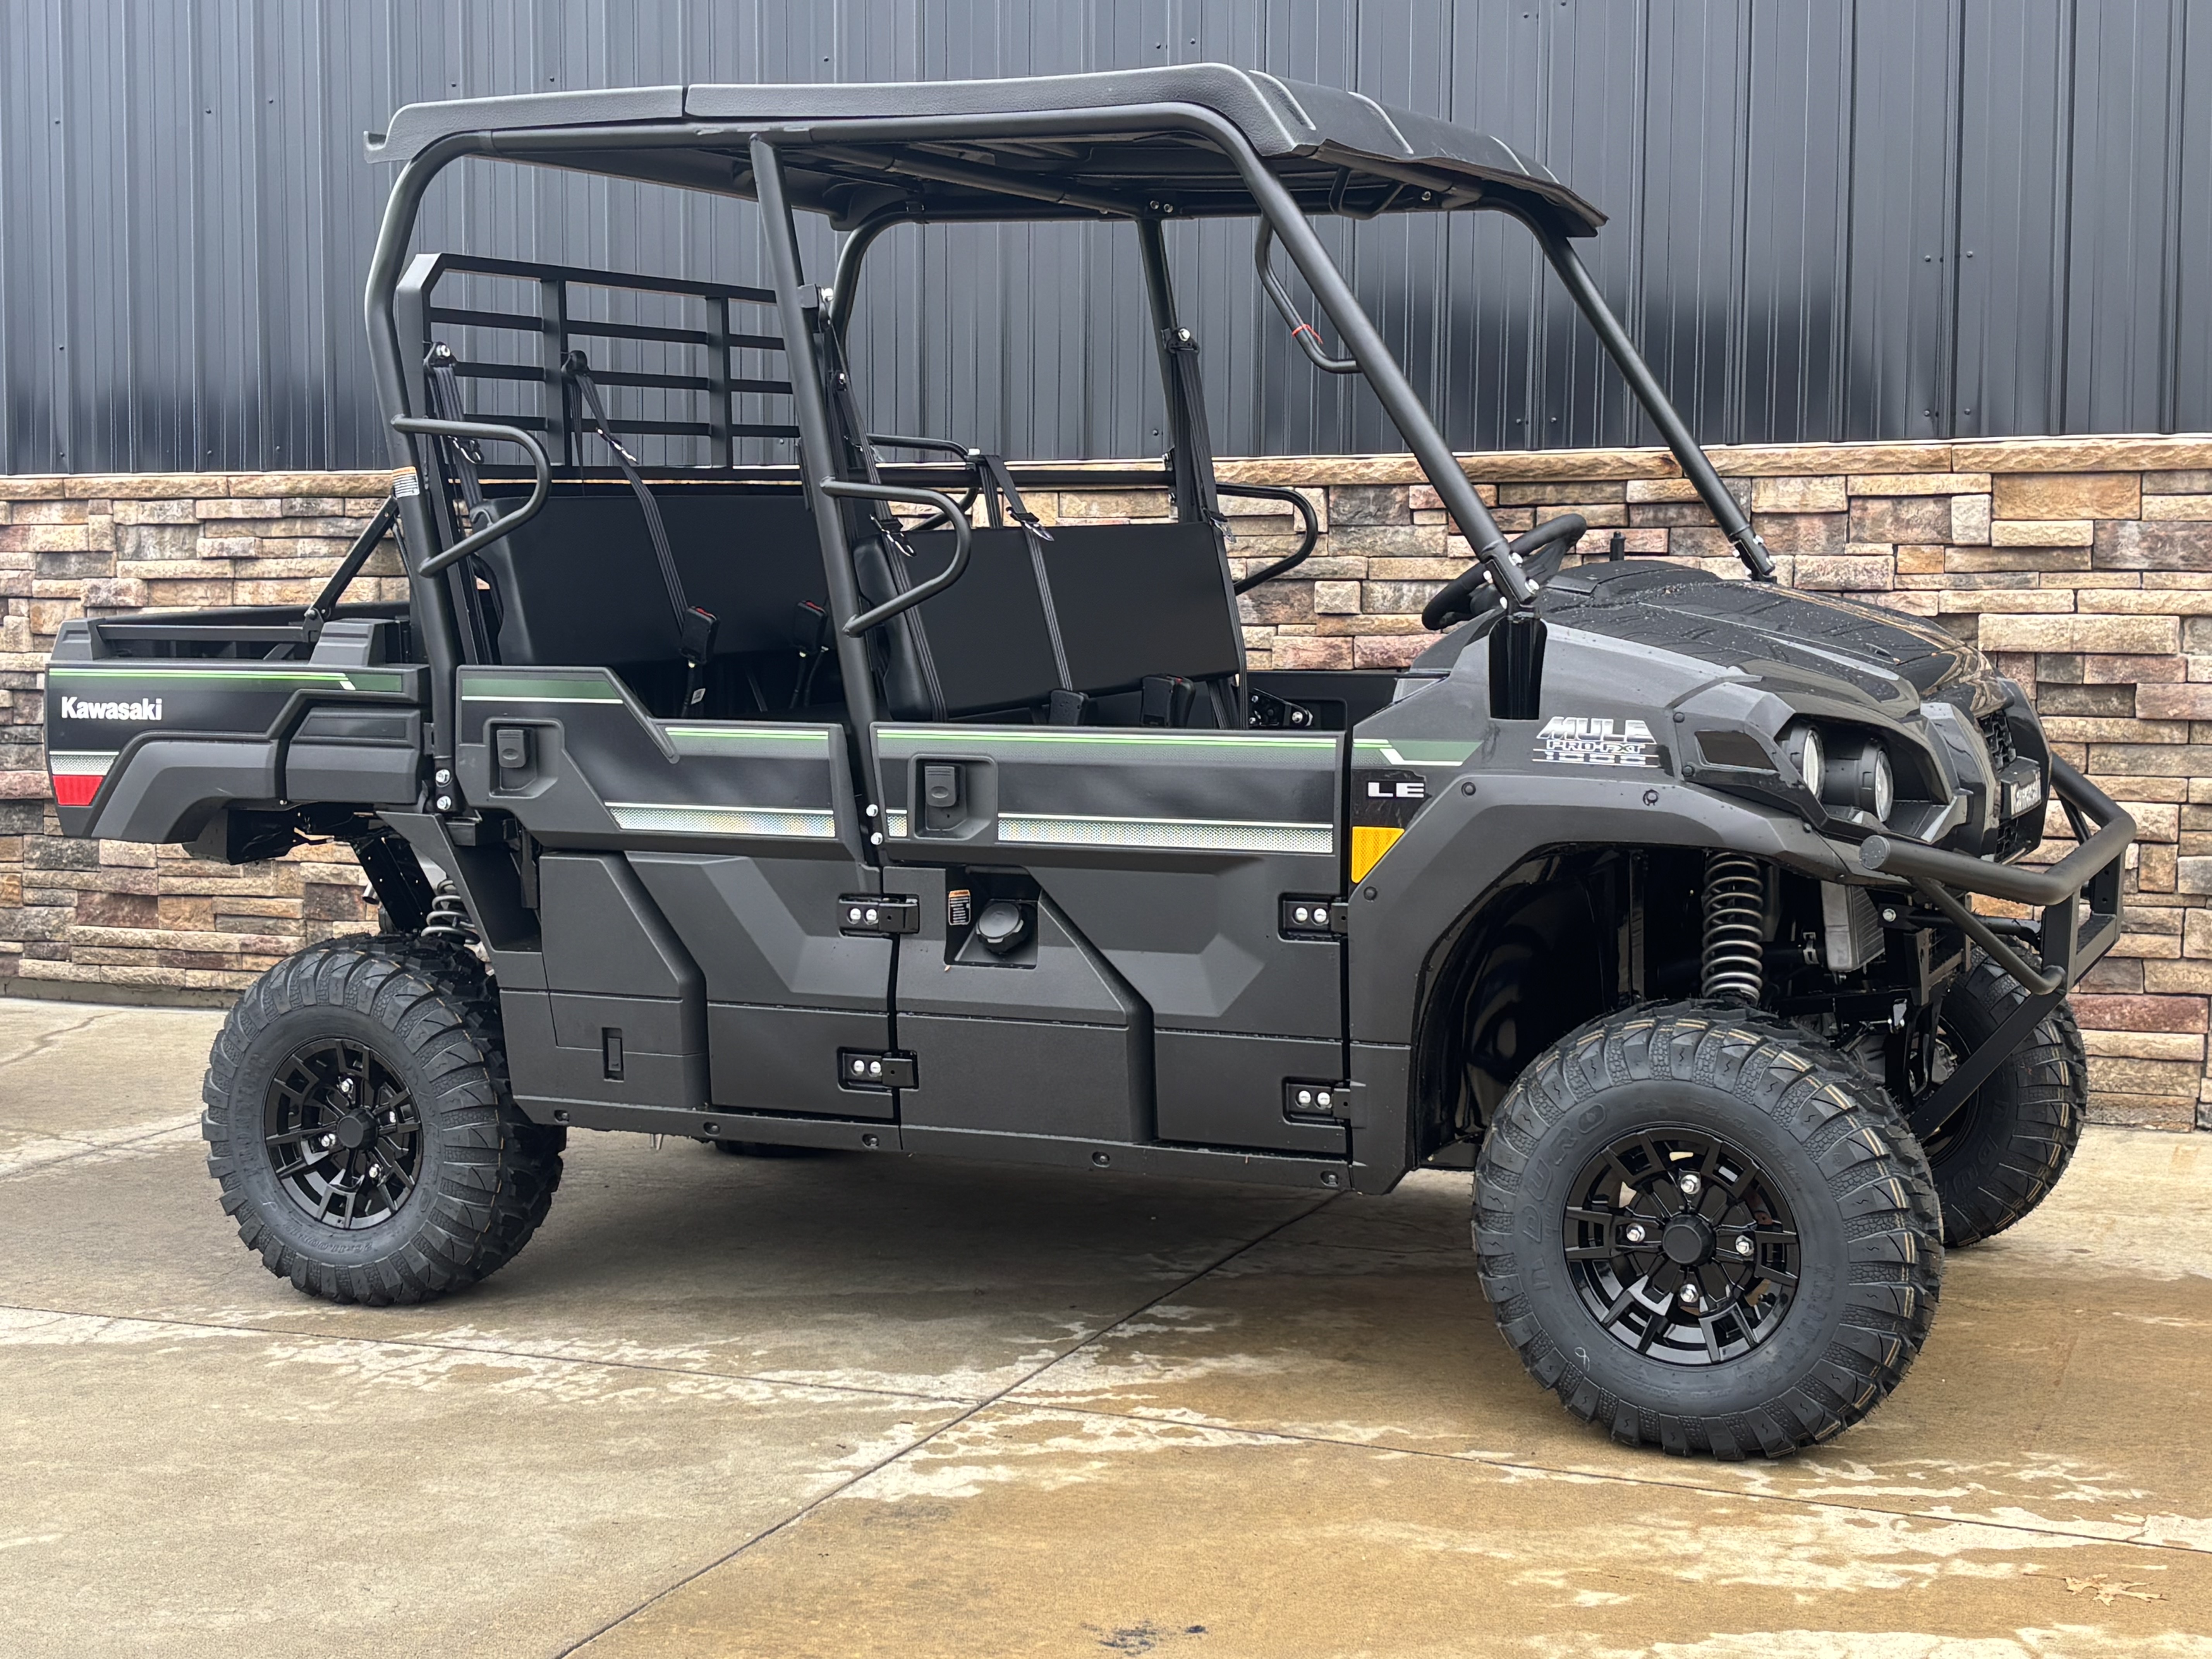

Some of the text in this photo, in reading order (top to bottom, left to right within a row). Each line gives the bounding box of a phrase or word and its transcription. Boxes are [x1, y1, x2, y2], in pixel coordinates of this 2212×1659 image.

[61, 696, 162, 720] Kawasaki
[1536, 716, 1657, 744] MULE
[1368, 782, 1424, 798] LE
[1522, 1103, 1606, 1243] DURO
